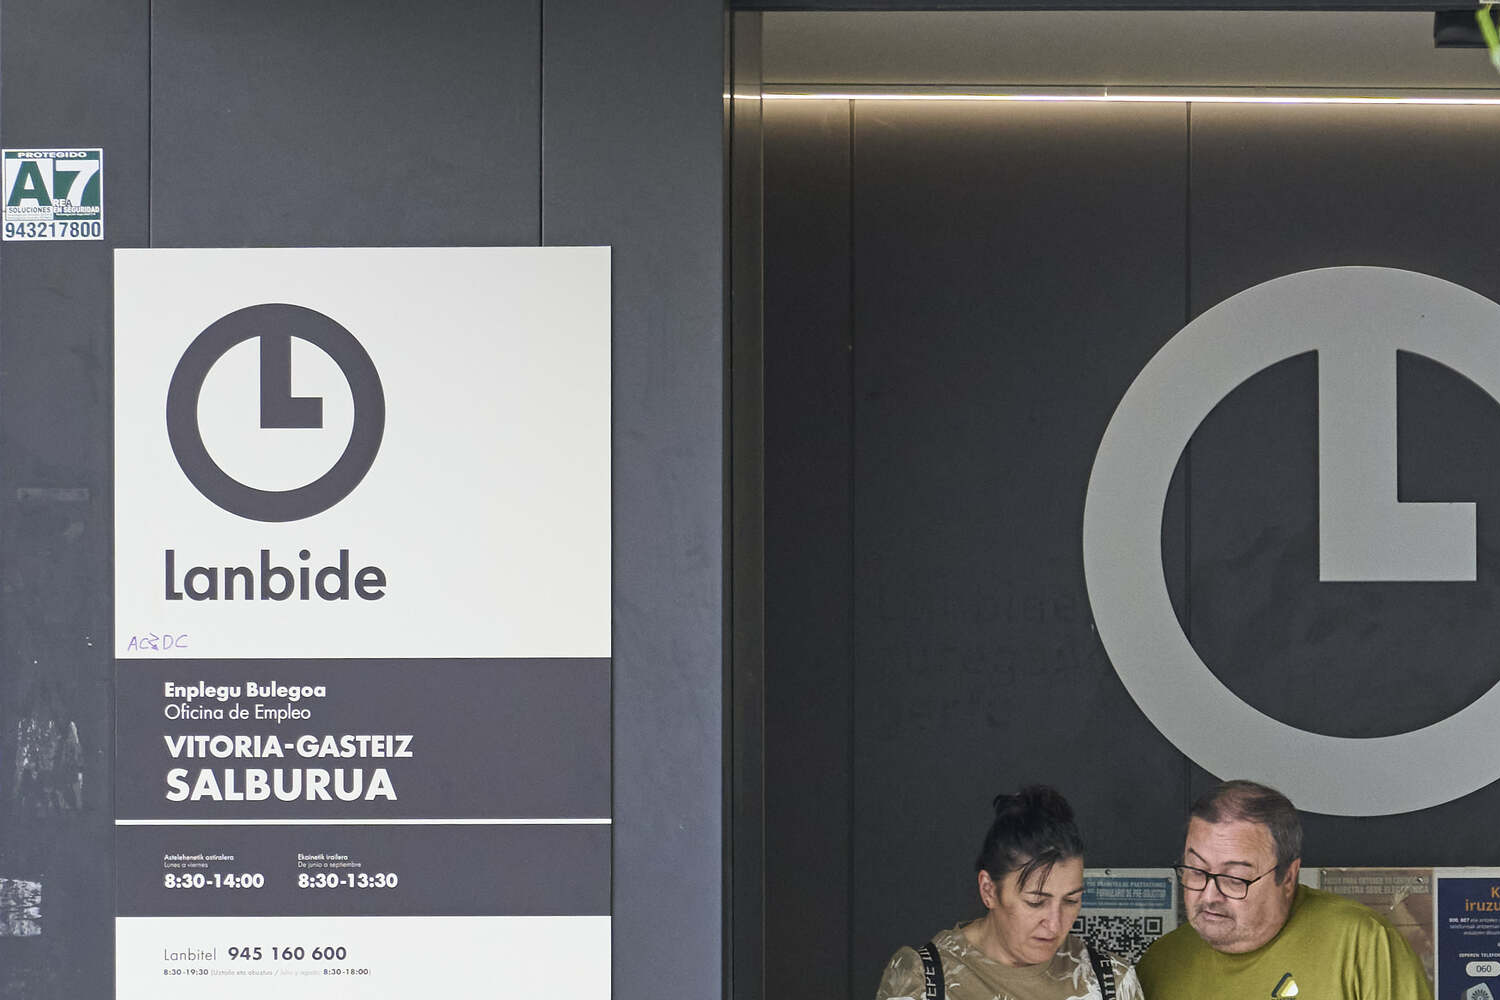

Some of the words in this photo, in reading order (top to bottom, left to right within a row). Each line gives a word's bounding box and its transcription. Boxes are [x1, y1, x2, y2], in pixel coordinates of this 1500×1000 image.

[5, 221, 100, 238] 943217800
[164, 681, 241, 701] Enplegu
[247, 681, 326, 701] Bulegoa
[164, 703, 223, 720] Oficina
[229, 703, 249, 720] de
[255, 703, 311, 723] Empleo
[164, 735, 414, 758] VITORIA-GASTEIZ
[166, 768, 397, 801] SALBURUA
[164, 873, 265, 888] 8:30-14:00
[298, 873, 398, 888] 8:30-13:30
[164, 948, 216, 961] Lanbitel
[228, 946, 263, 961] 945
[271, 946, 305, 961] 160
[311, 946, 347, 961] 600
[163, 968, 209, 976] 8:30-19:30
[1476, 965, 1492, 973] 060
